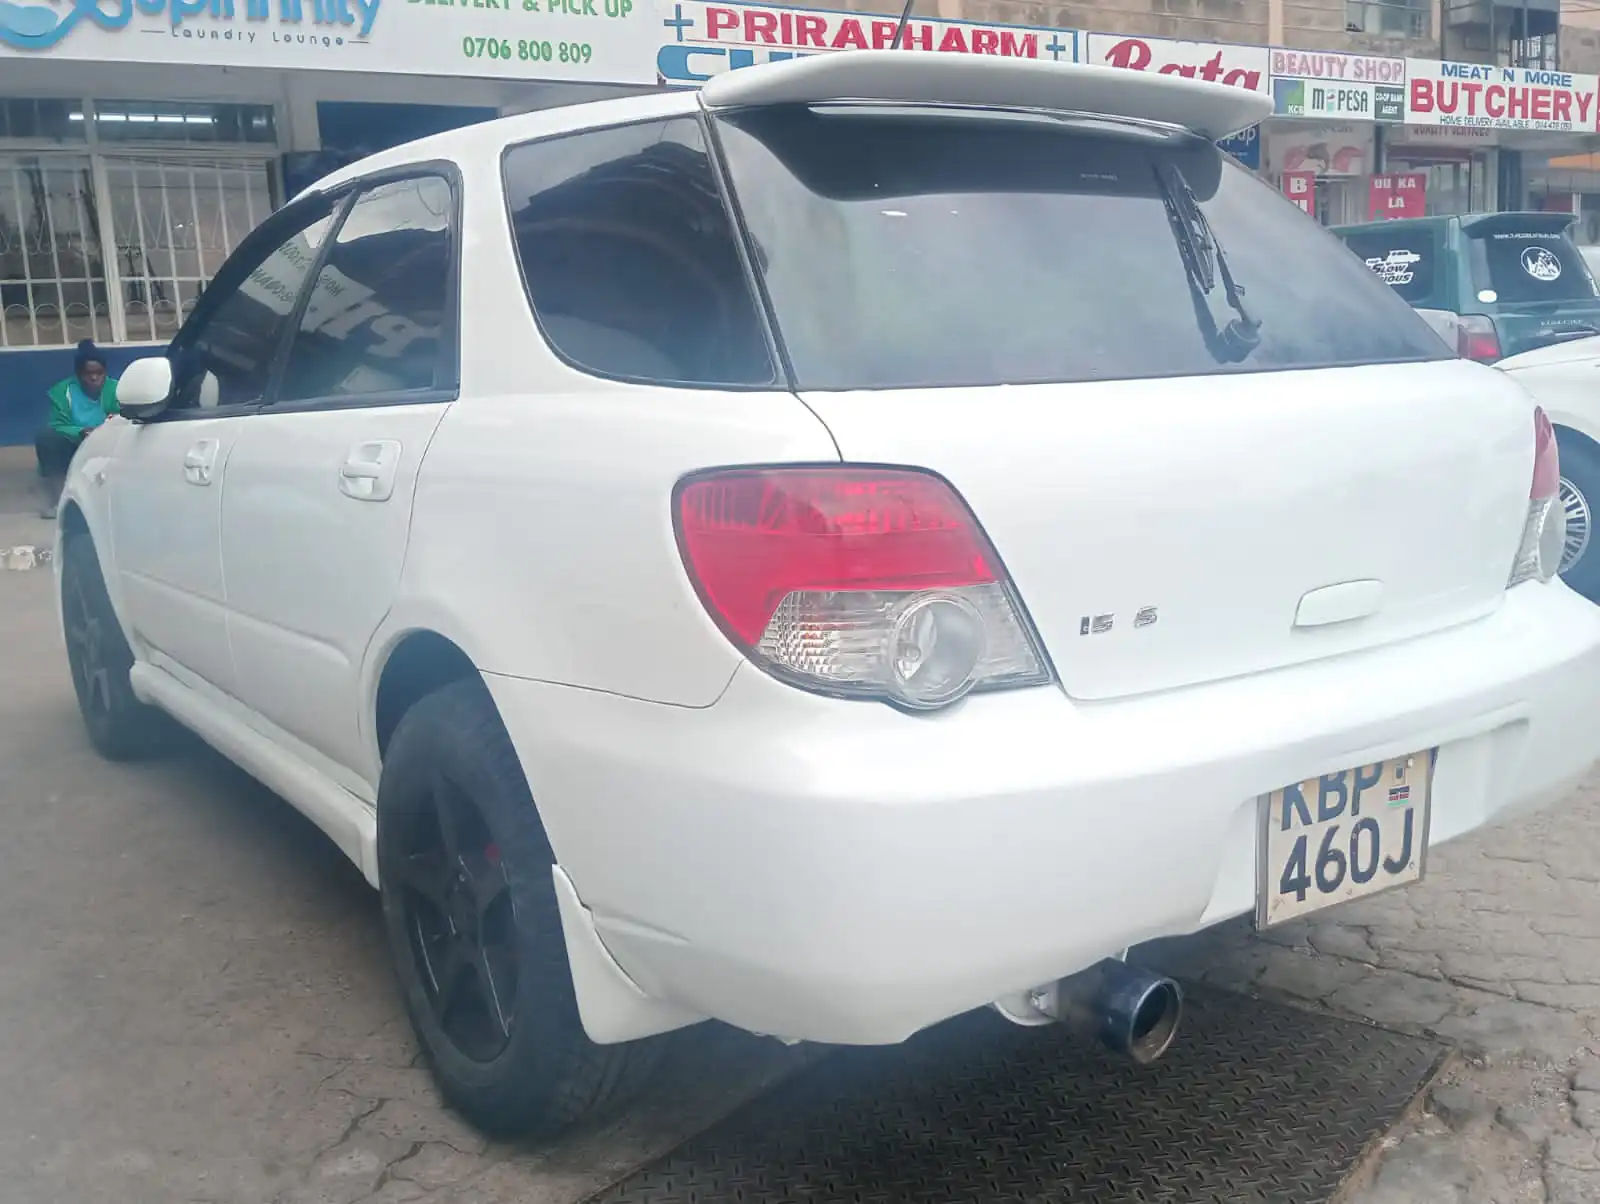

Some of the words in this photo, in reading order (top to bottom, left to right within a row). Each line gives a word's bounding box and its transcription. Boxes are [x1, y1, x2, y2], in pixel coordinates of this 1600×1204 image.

[549, 0, 598, 16] PICK
[604, 0, 632, 18] UP
[171, 24, 256, 42] Laundry
[272, 31, 343, 47] Lounge
[706, 7, 1038, 58] PRIRAPHARM
[462, 36, 511, 59] 0706
[518, 39, 553, 62] 800
[558, 42, 592, 64] 809
[1272, 52, 1347, 78] BEAUTY
[1353, 58, 1403, 82] SHOP
[1442, 63, 1492, 80] MEAT
[1525, 71, 1572, 87] MORE
[1410, 78, 1594, 123] BUTCHERY
[1281, 761, 1385, 832] KBP
[1280, 807, 1414, 902] 460J
